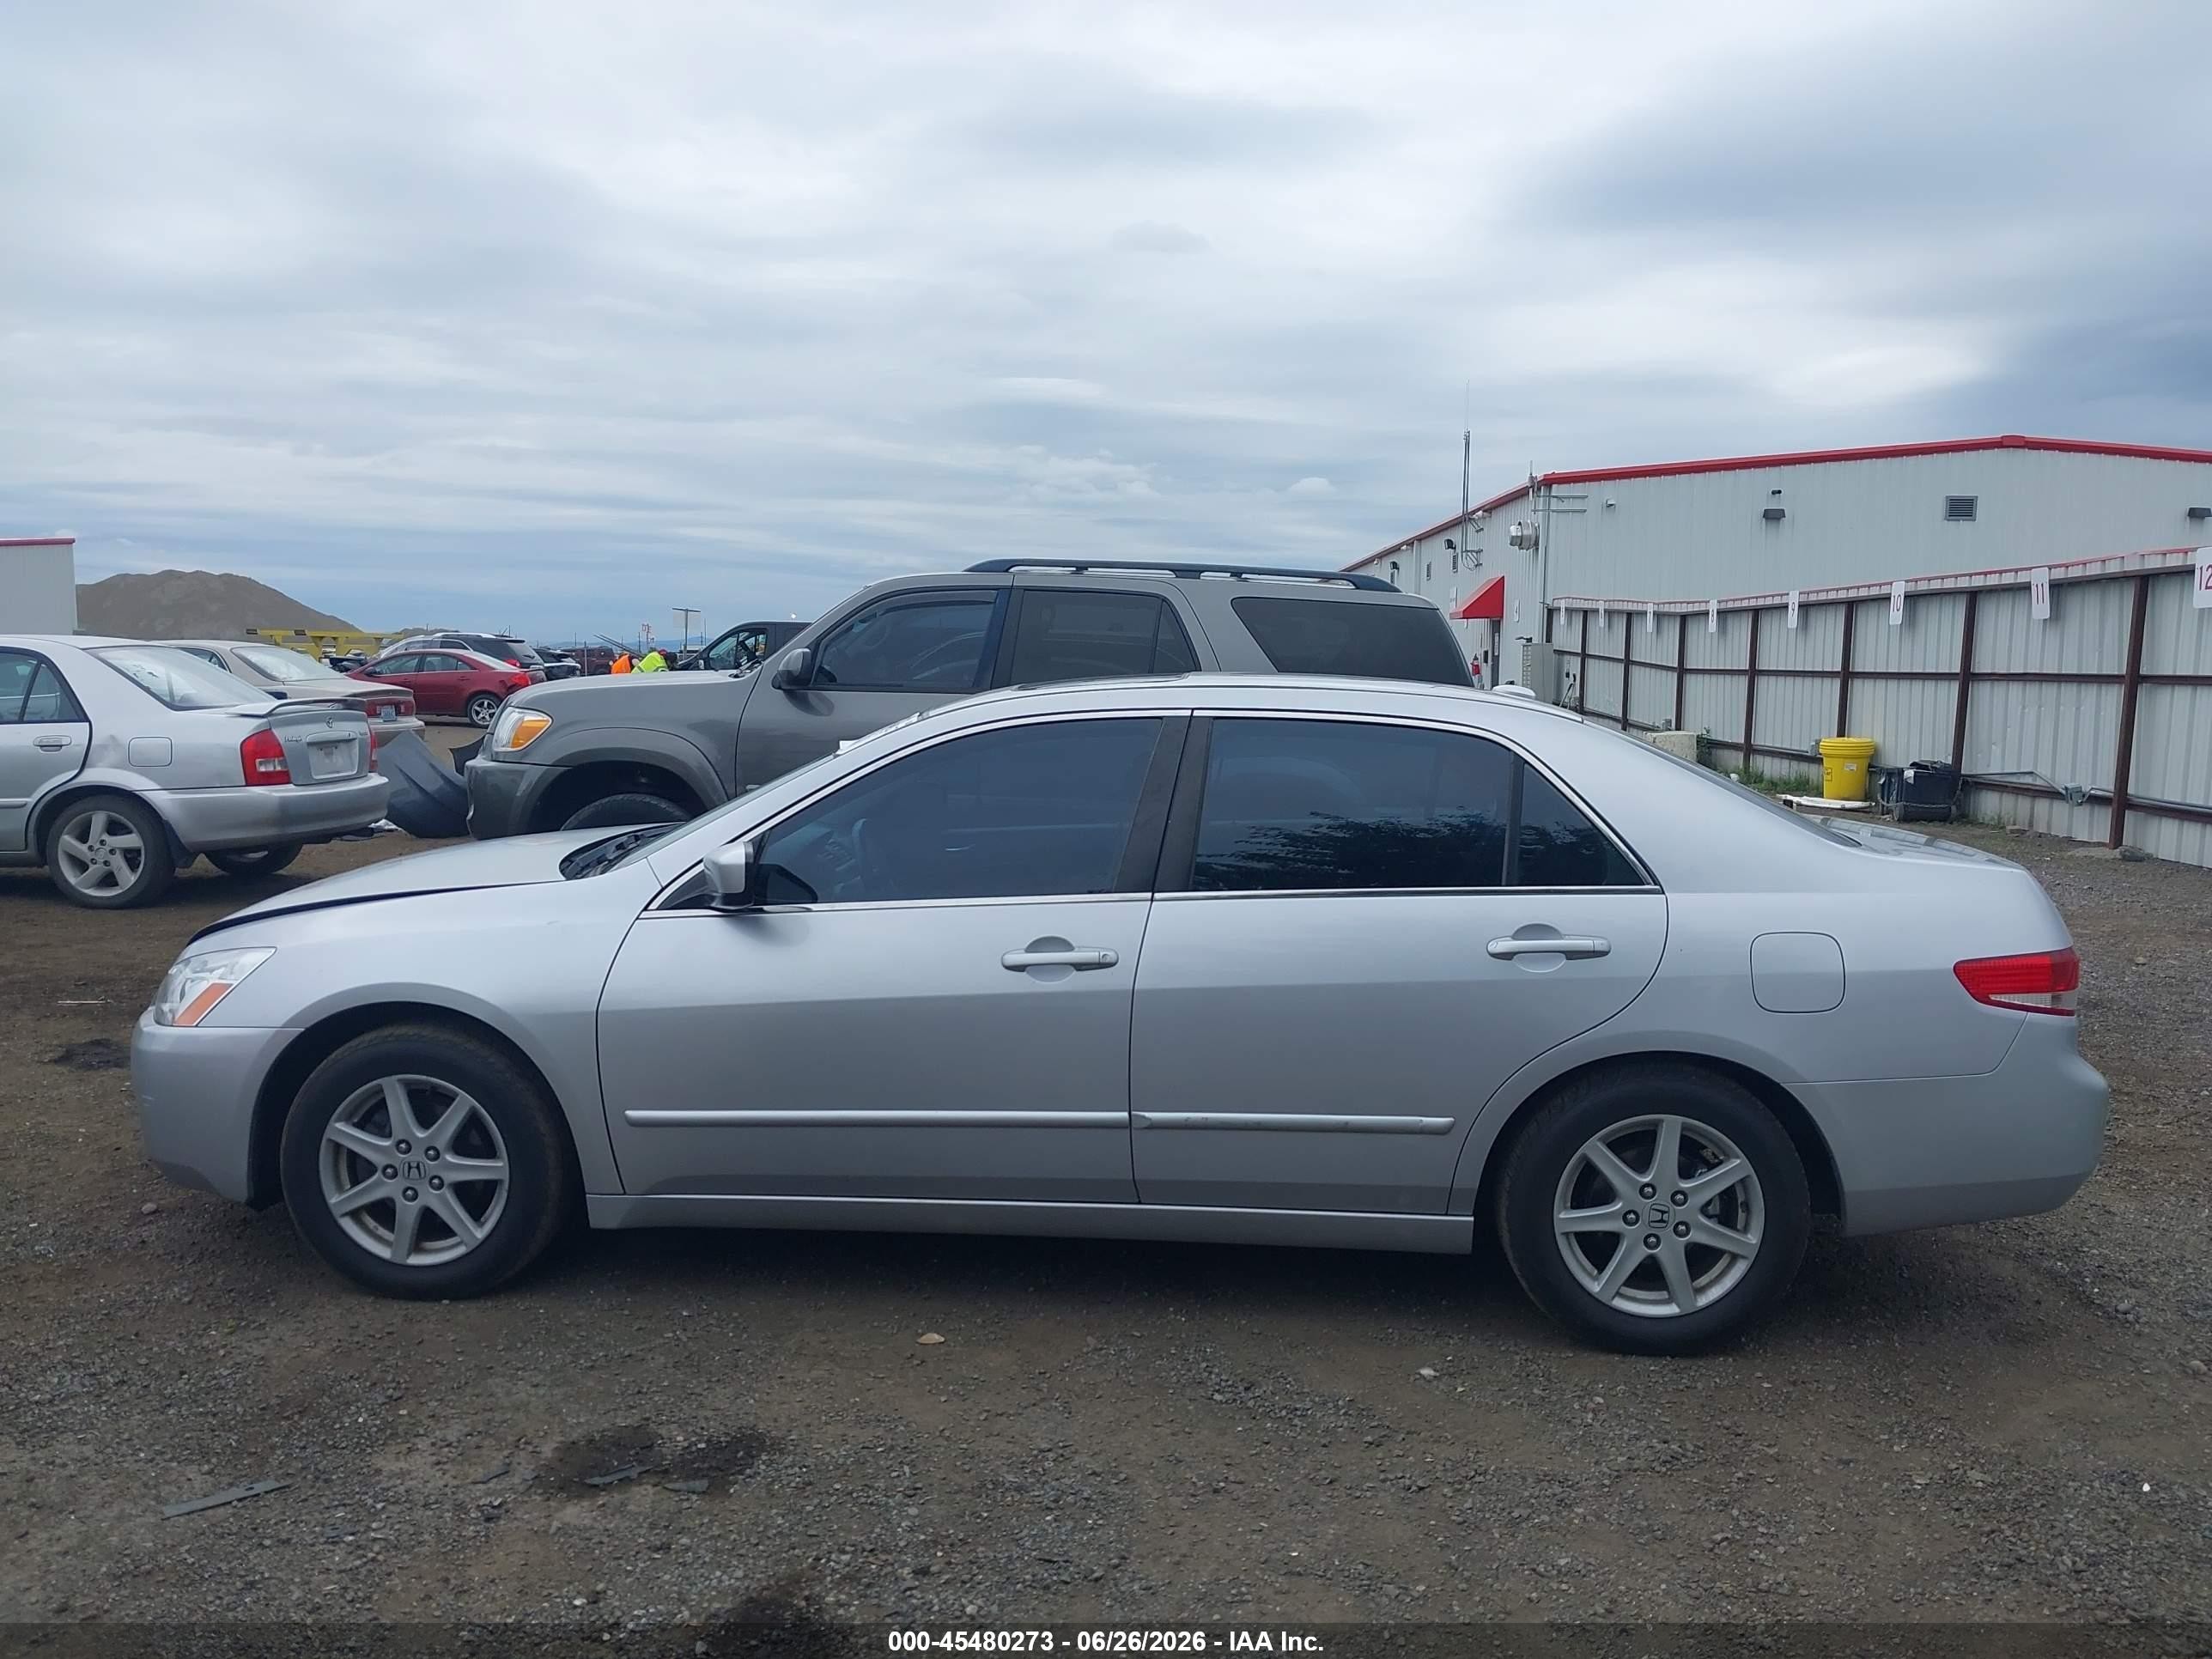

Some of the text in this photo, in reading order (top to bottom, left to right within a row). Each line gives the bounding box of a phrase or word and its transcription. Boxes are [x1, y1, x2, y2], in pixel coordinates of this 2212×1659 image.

[2199, 564, 2212, 592] 12
[1892, 593, 1902, 612] 10
[2034, 583, 2045, 605] 11
[1711, 609, 1715, 623] 8
[1790, 601, 1796, 617] 9
